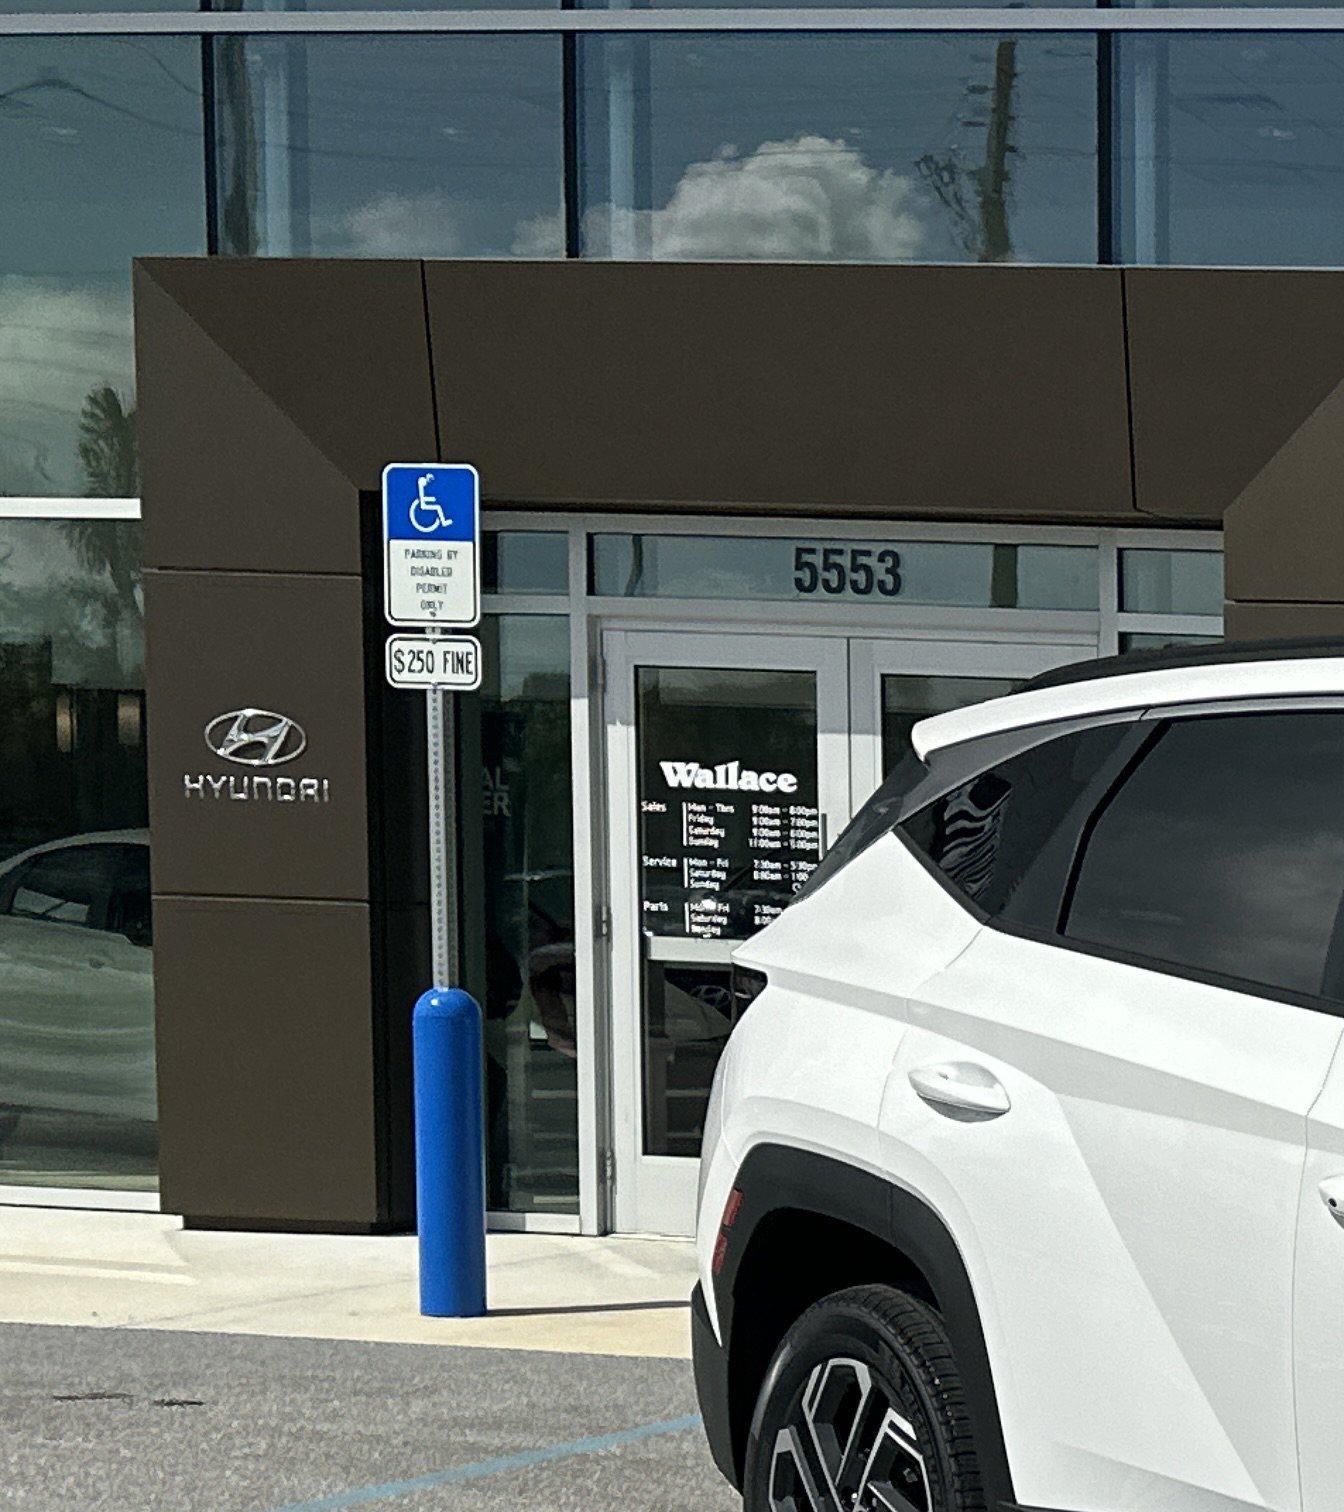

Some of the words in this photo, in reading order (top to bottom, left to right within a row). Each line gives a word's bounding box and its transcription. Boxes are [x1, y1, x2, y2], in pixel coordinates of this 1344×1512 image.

[404, 549, 443, 560] PARKING
[447, 549, 458, 560] BY
[410, 566, 452, 577] DISABLED
[793, 545, 902, 597] 5553
[416, 583, 448, 594] PERMIT
[420, 600, 444, 611] ONLY
[393, 647, 435, 675] $250
[443, 650, 474, 676] FINE
[659, 760, 798, 793] Wallace
[184, 774, 330, 803] HYUNDAI
[642, 855, 677, 867] Service
